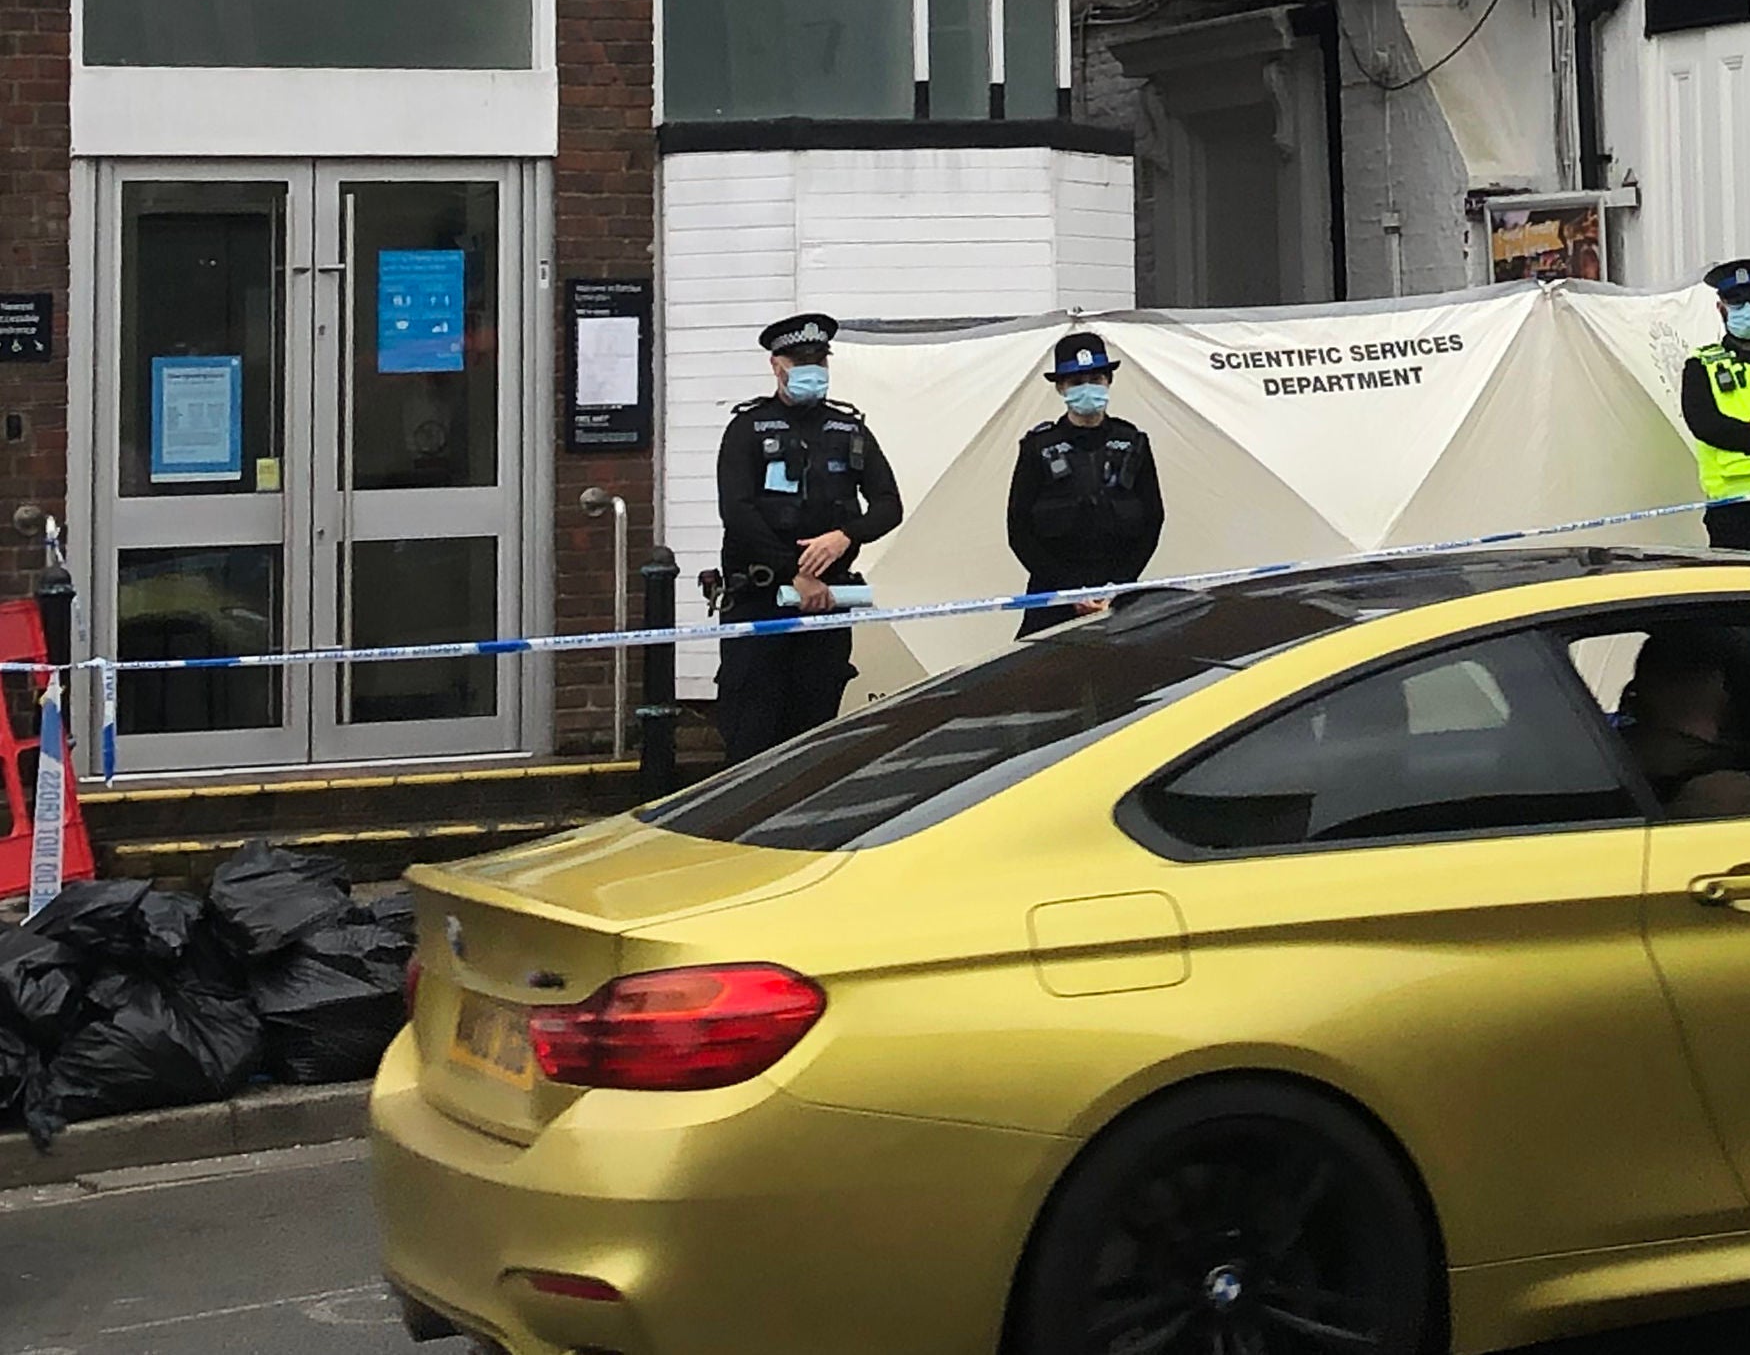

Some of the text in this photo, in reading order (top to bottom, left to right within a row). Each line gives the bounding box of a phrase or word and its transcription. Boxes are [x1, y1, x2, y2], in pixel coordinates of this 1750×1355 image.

[1209, 334, 1464, 370] SCIENTIFIC SERVICES
[1263, 366, 1424, 397] DEPARTMENT
